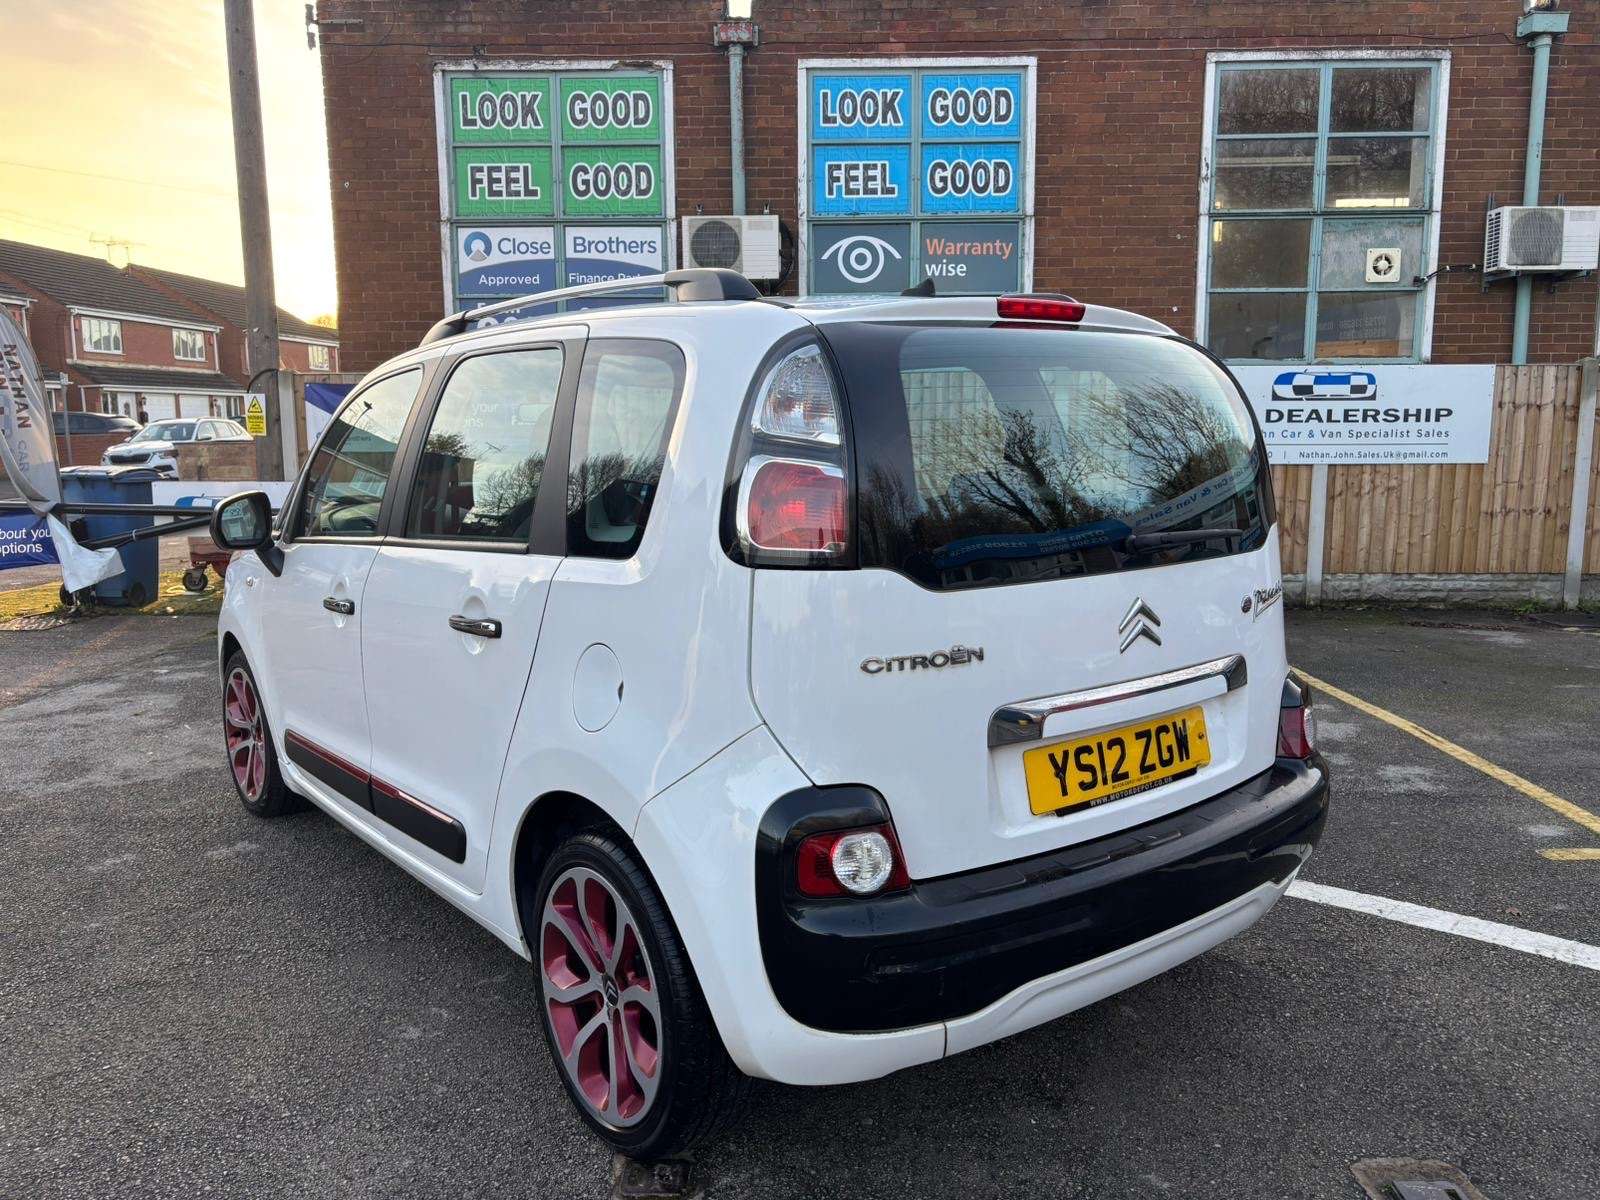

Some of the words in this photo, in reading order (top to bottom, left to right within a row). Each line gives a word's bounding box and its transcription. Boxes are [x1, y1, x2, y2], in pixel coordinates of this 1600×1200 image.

[459, 91, 543, 129] LOOK
[568, 90, 652, 129] GOOD
[820, 88, 904, 127] LOOK
[928, 87, 1014, 126] GOOD
[468, 163, 540, 199] FEEL
[570, 162, 654, 199] GOOD
[825, 161, 898, 198] FEEL
[927, 160, 1012, 197] GOOD
[497, 237, 551, 255] Close
[573, 236, 658, 254] Brothers
[926, 238, 1013, 261] Warranty
[478, 273, 540, 286] Approved
[925, 258, 967, 276] wise
[4, 344, 32, 428] NATHAN
[1265, 407, 1454, 423] DEALERSHIP
[1281, 430, 1302, 439] Car
[1308, 430, 1315, 438] &
[1320, 429, 1342, 438] Van
[1347, 429, 1410, 440] Specialist
[1416, 429, 1450, 438] Sales
[1048, 736, 1129, 797] YS12
[1135, 719, 1190, 775] ZGW
